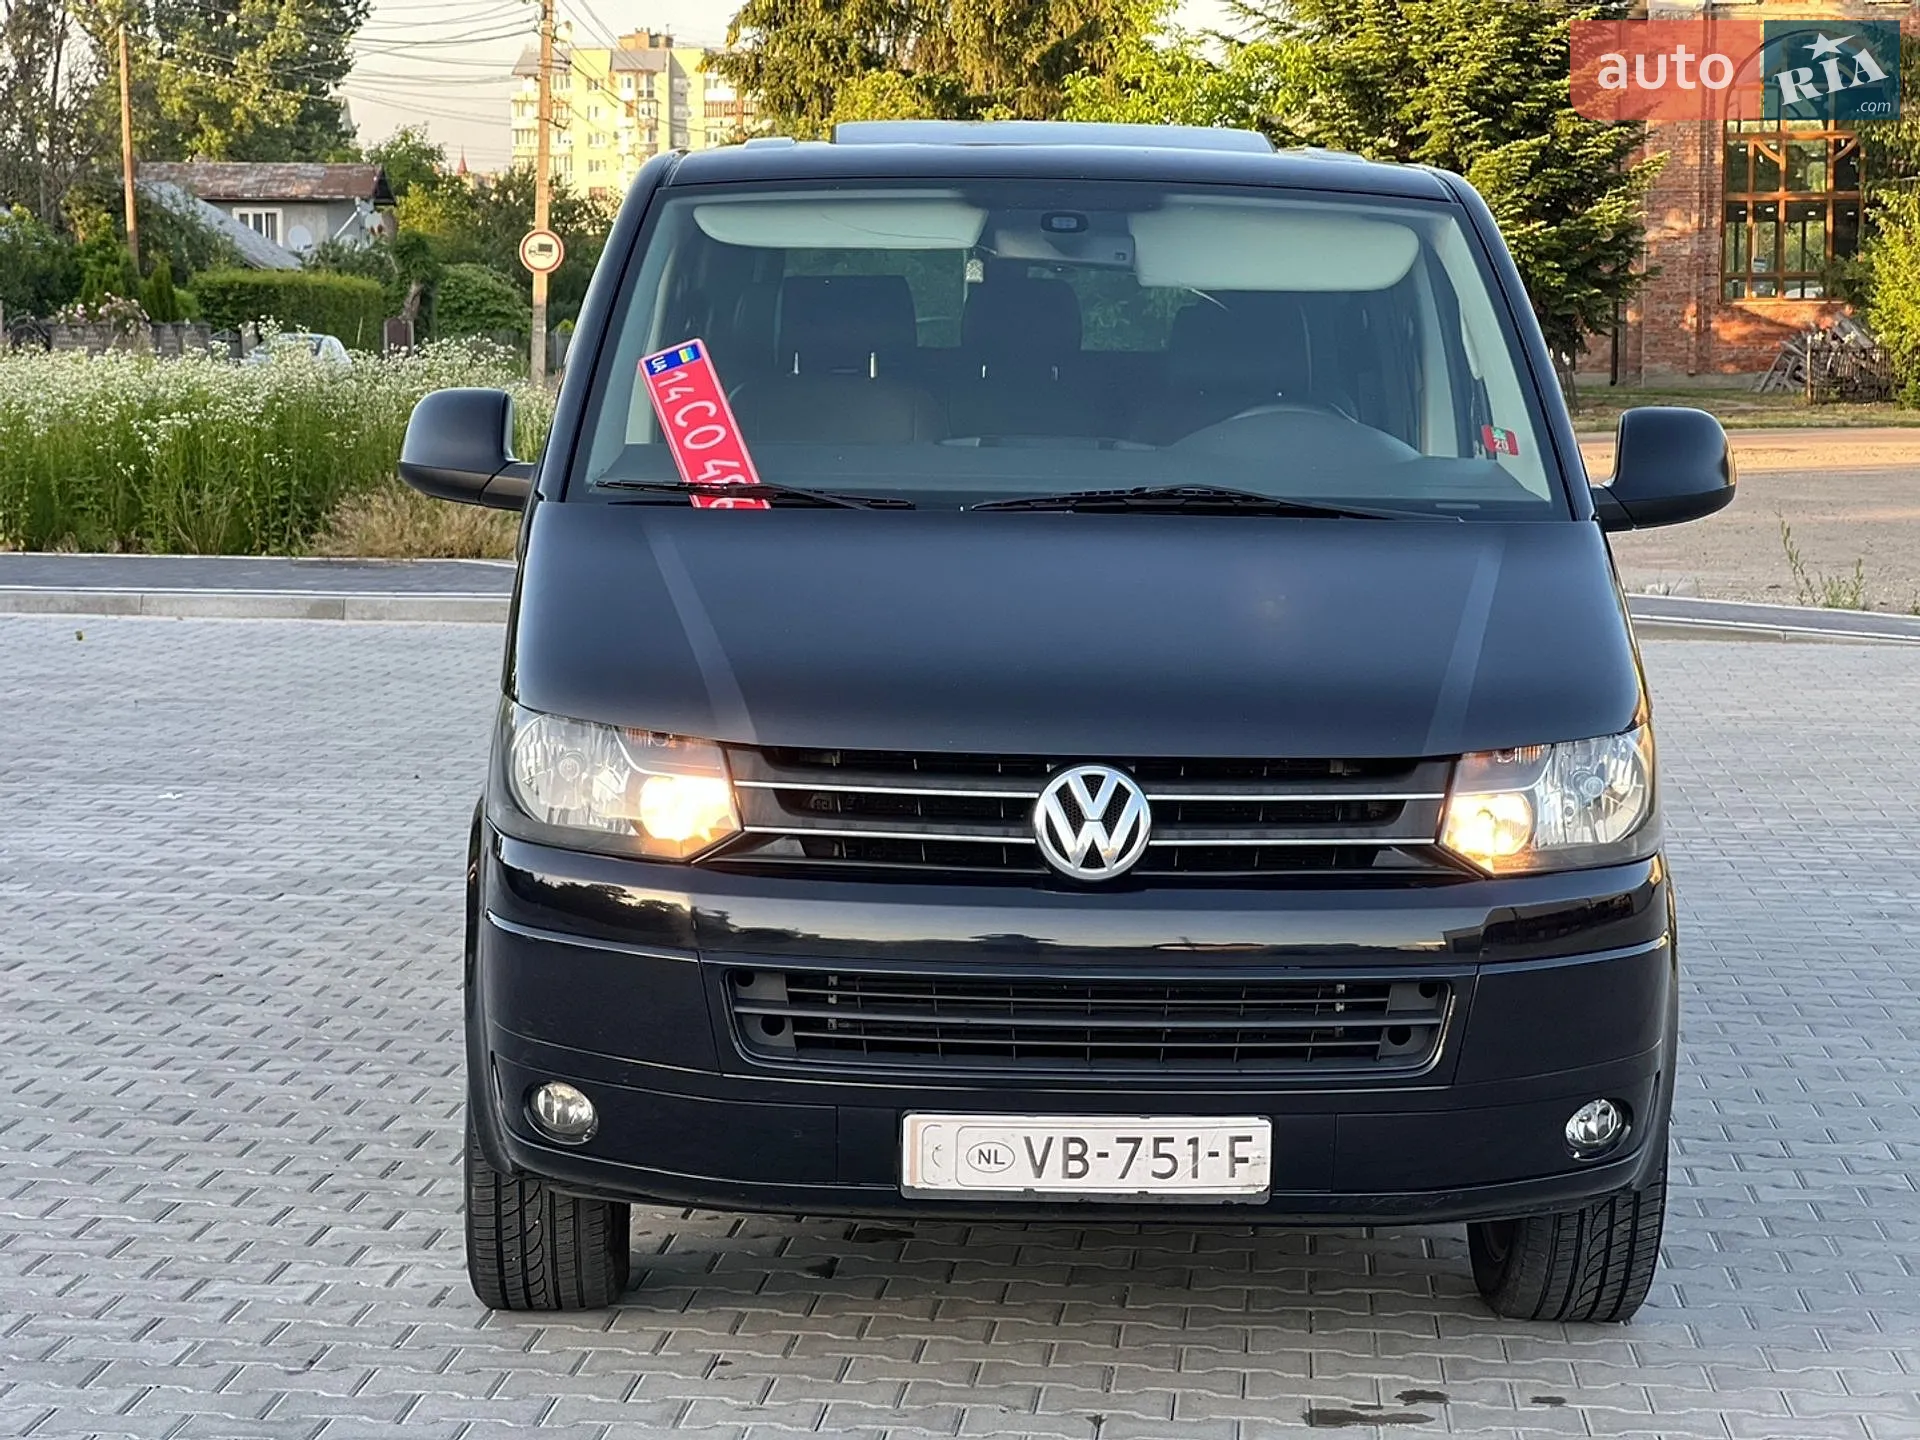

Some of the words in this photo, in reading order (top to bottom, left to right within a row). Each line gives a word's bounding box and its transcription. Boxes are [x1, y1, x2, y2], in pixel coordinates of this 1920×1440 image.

[651, 355, 667, 373] UA
[1039, 768, 1146, 877] VW
[978, 1149, 1006, 1165] NL
[1023, 1135, 1253, 1180] VB-751-F
